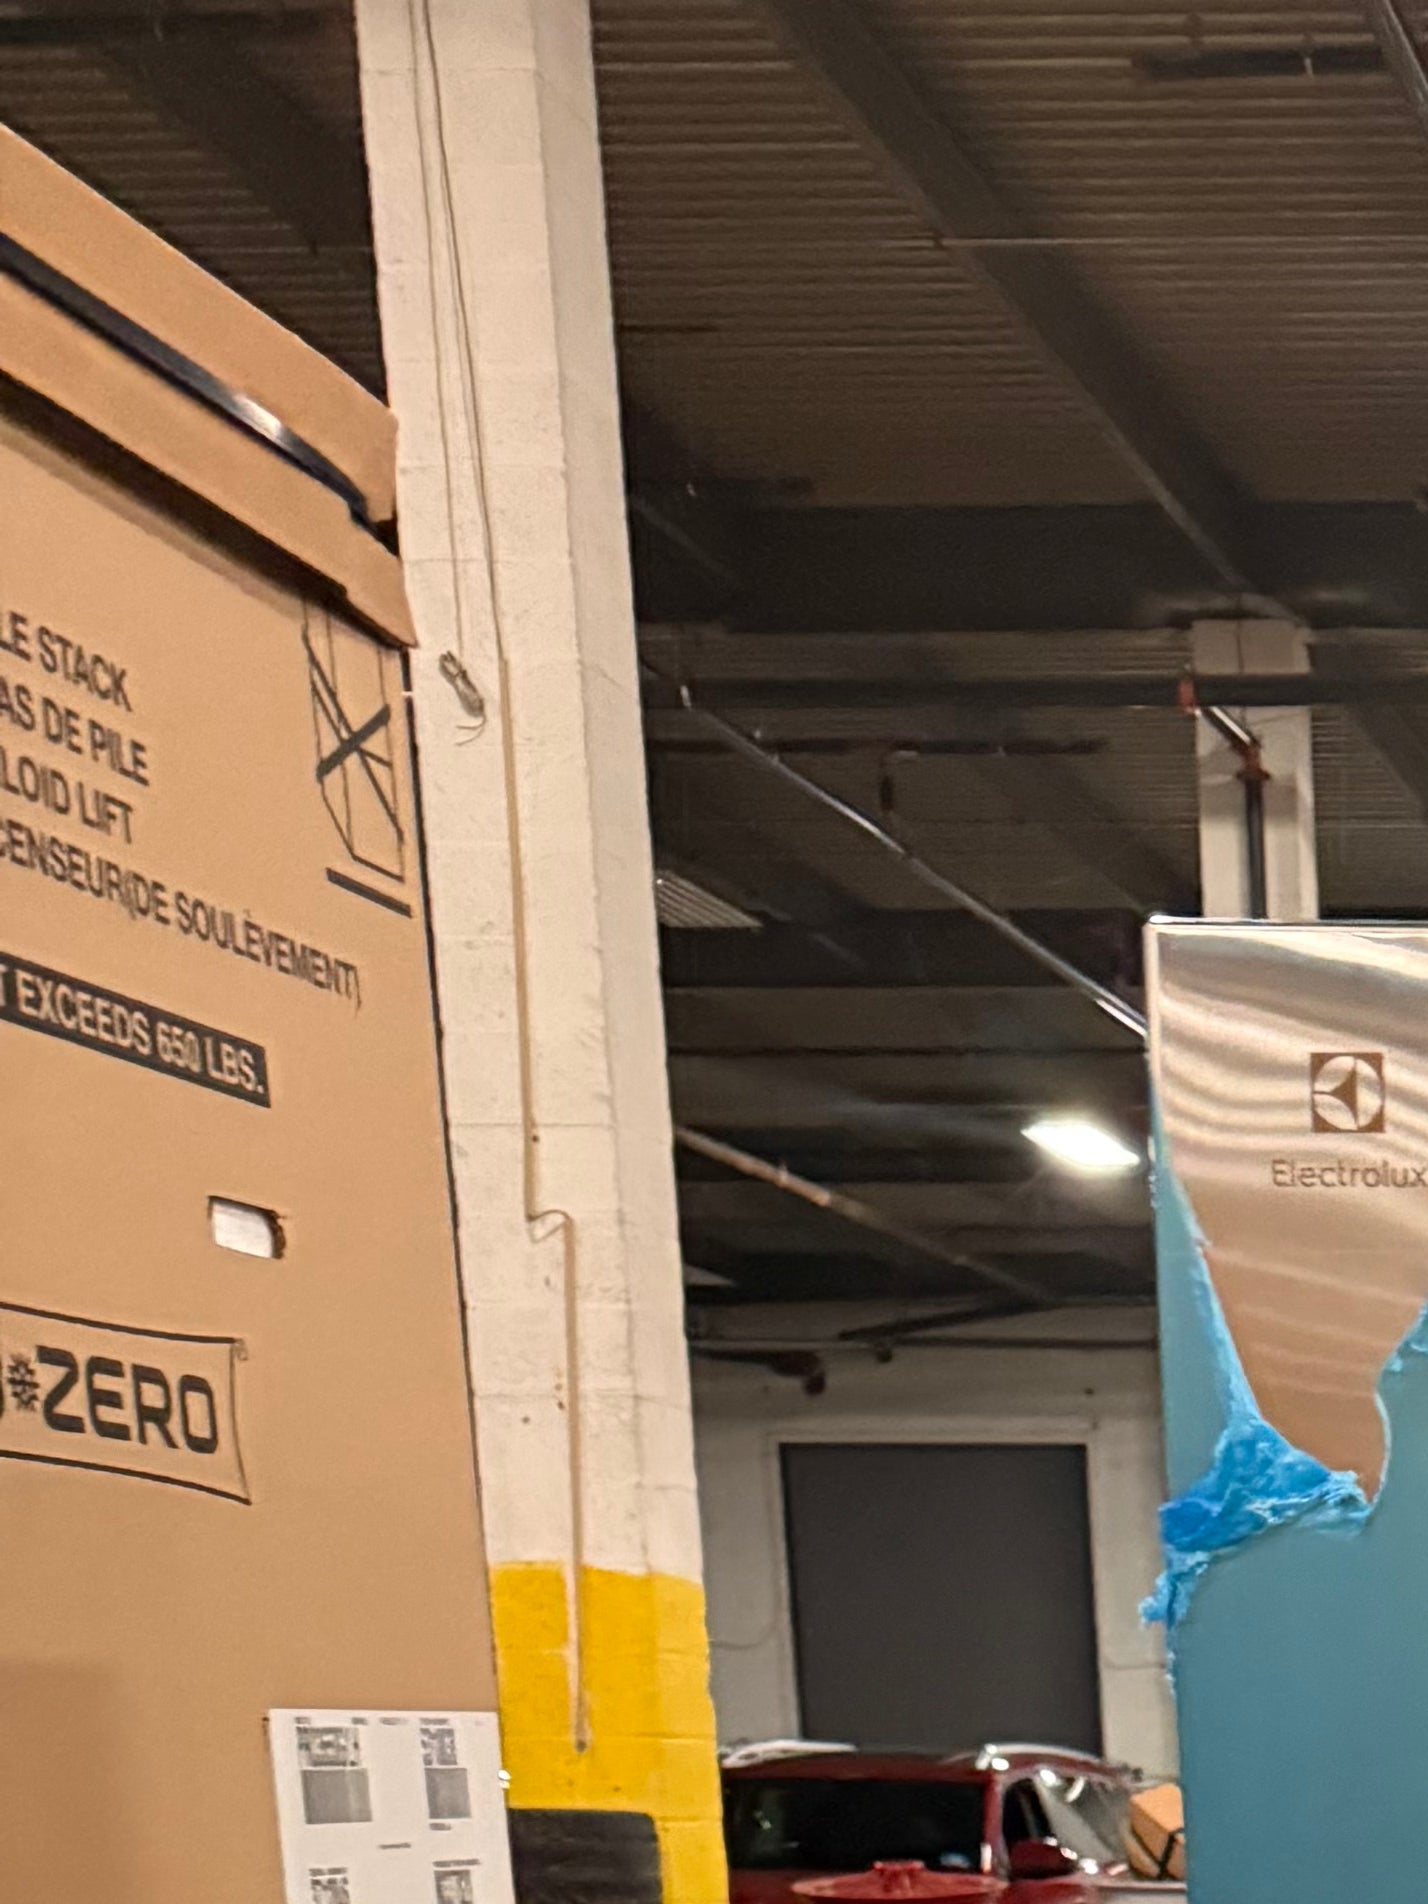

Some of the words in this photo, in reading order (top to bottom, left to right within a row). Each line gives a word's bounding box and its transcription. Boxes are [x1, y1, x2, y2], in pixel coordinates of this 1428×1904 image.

[38, 625, 132, 713] STACK
[43, 696, 83, 755] DE
[88, 719, 150, 786] PILE
[77, 781, 133, 844] LIFT
[15, 969, 151, 1053] EXCEEDS
[156, 1021, 200, 1073] 650
[203, 1036, 265, 1095] LBS.
[36, 1345, 218, 1455] ZERO
